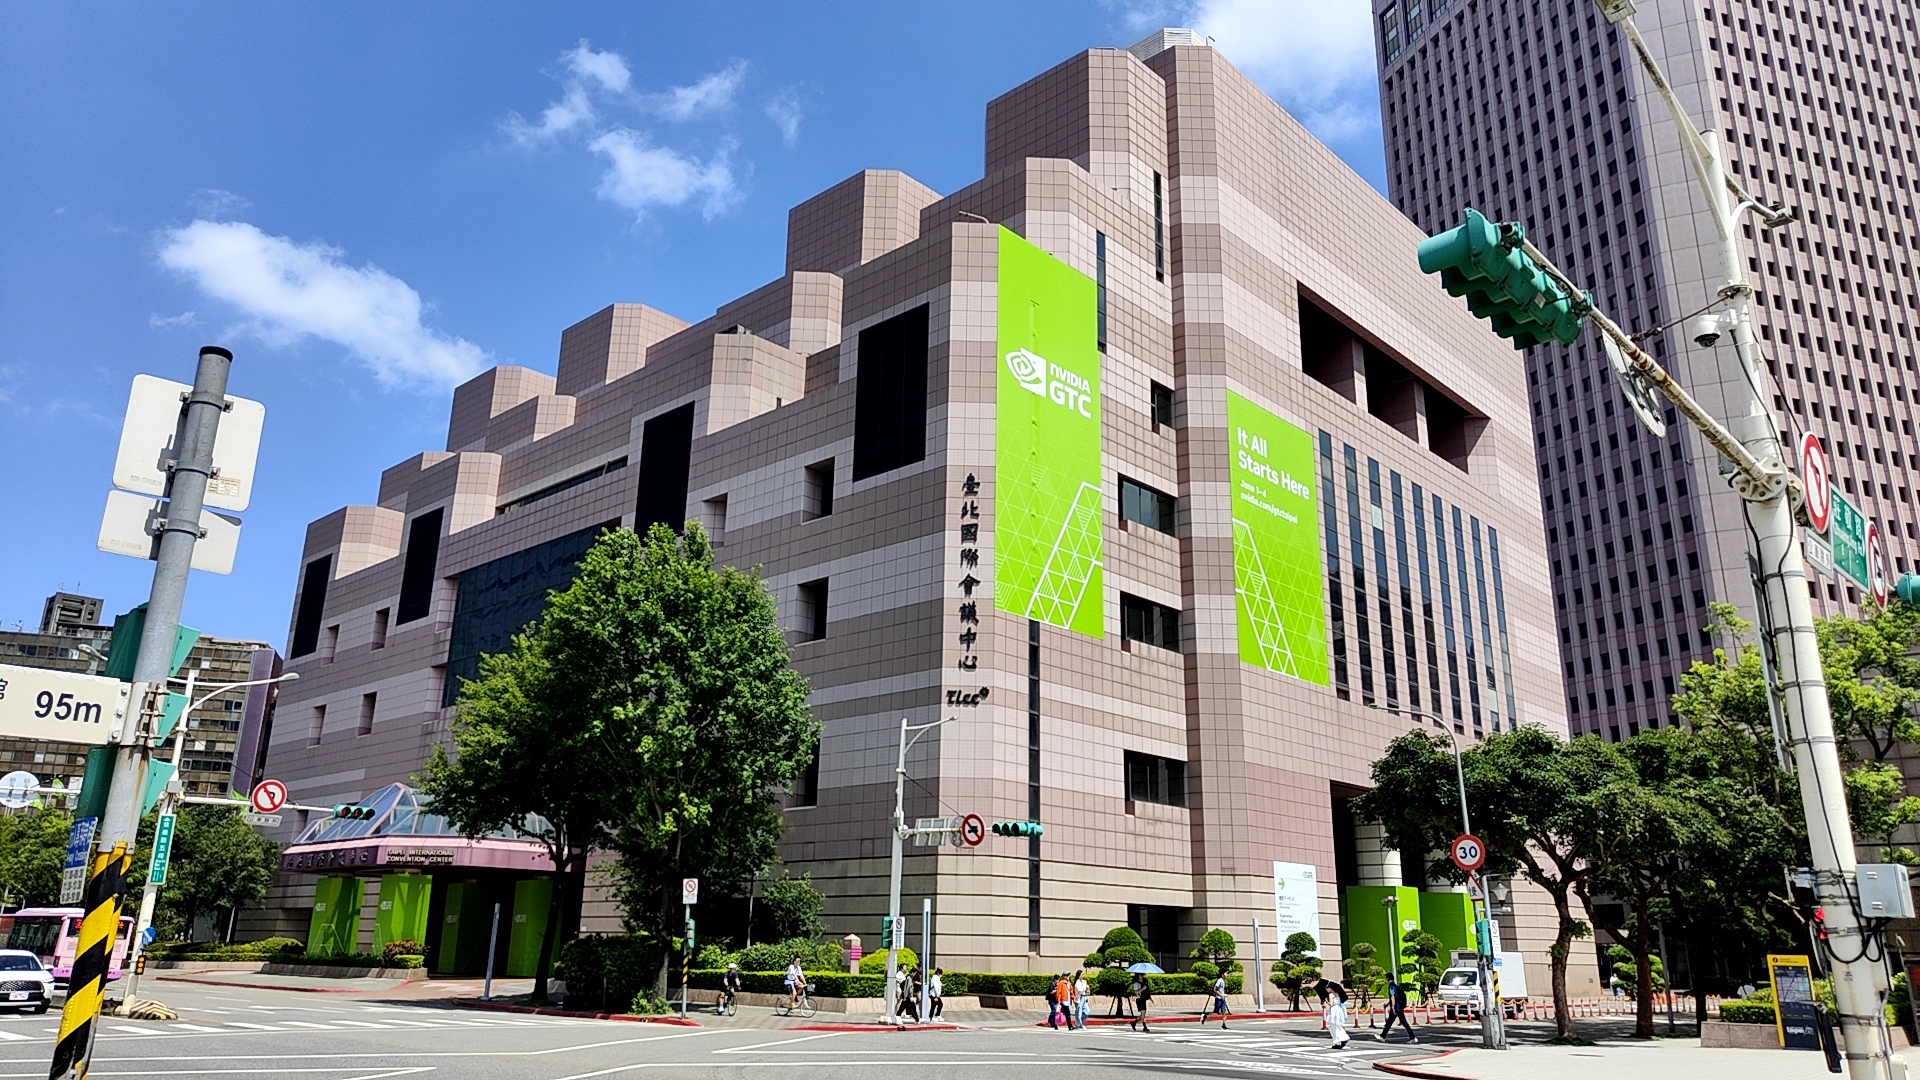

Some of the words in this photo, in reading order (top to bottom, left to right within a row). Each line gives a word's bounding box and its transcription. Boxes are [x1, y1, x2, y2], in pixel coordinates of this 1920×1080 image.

[1049, 380, 1091, 419] GTC
[1237, 427, 1248, 449] It
[1251, 435, 1268, 458] All
[1238, 449, 1279, 485] Starts
[1281, 470, 1310, 500] Here
[1240, 479, 1255, 493] June
[1240, 492, 1298, 524] nvidia.com/gtctaipei
[957, 472, 982, 672] 臺北國際會議中心
[34, 690, 102, 724] 95m
[409, 849, 454, 857] INTERNATIONAL
[1459, 846, 1478, 860] 30
